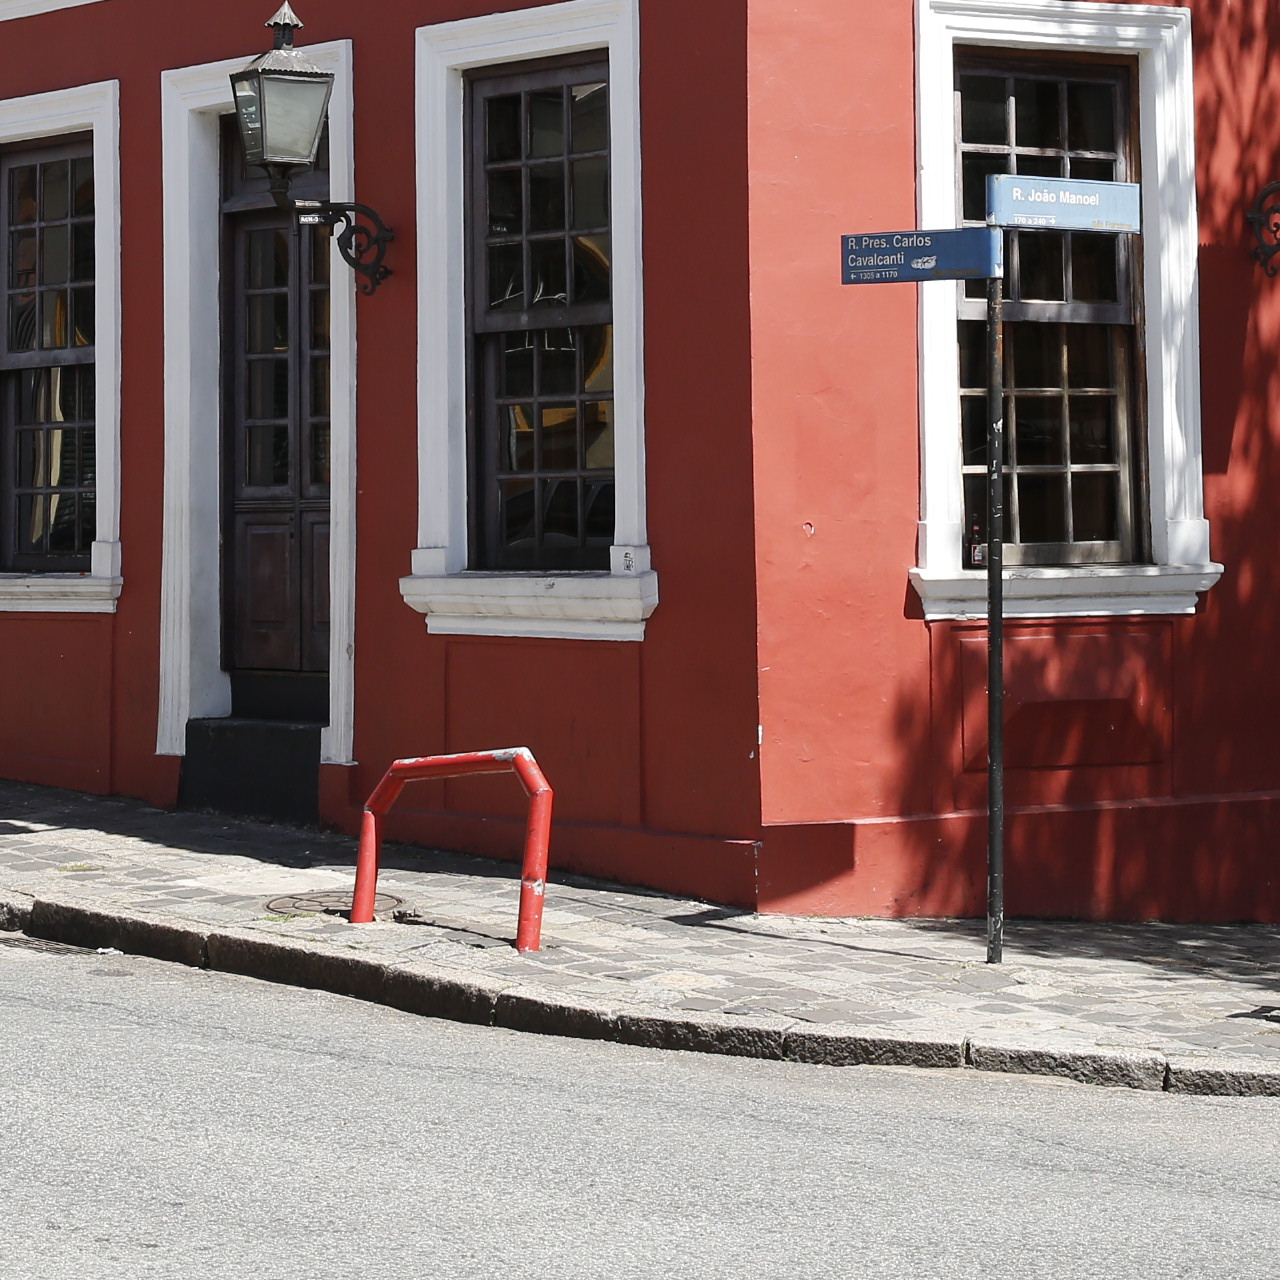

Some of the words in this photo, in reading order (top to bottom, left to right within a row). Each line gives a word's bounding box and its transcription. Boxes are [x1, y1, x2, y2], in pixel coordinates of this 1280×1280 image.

[1012, 187, 1025, 201] R.
[1028, 189, 1057, 203] João
[1059, 190, 1099, 206] Manoel
[1014, 216, 1026, 224] 170
[1033, 217, 1046, 225] 240
[848, 237, 859, 250] R.
[862, 236, 890, 249] Pres.
[893, 234, 932, 248] Carlos
[848, 251, 905, 267] Cavalcanti
[859, 272, 875, 280] 1305
[881, 270, 898, 278] 1170
